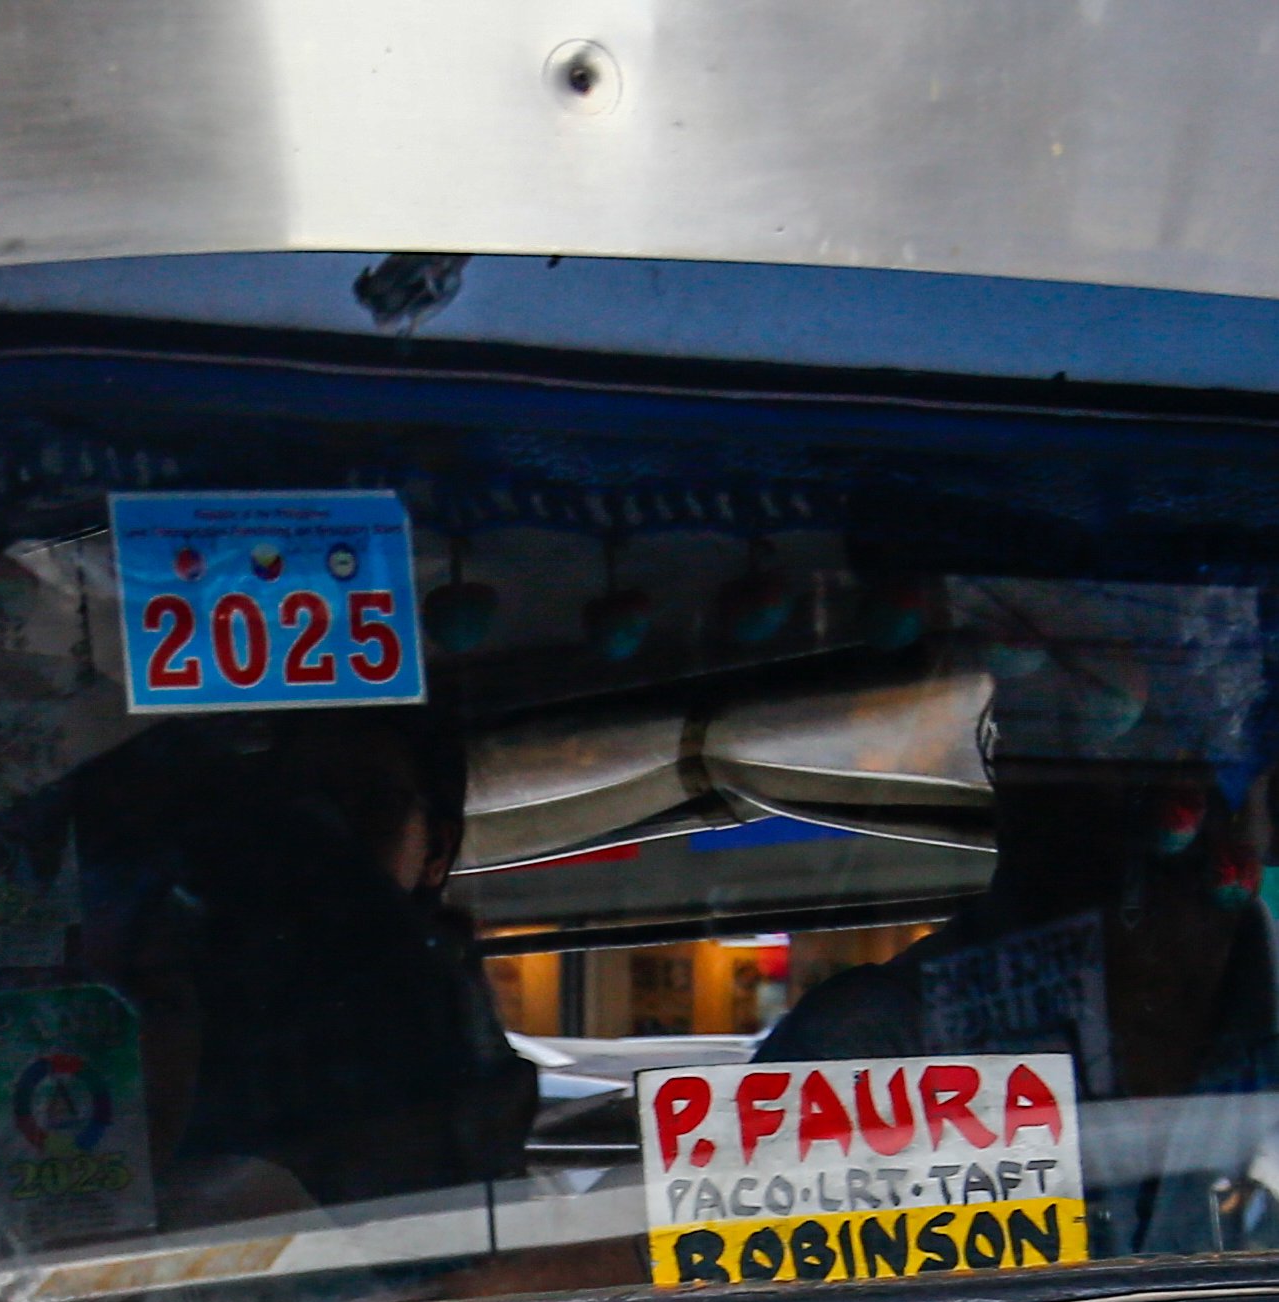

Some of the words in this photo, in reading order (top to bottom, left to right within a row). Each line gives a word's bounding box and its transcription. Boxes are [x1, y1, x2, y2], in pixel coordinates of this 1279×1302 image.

[144, 591, 402, 689] 2025
[10, 1153, 132, 1199] 2025
[674, 1203, 1061, 1284] ROBINSON
